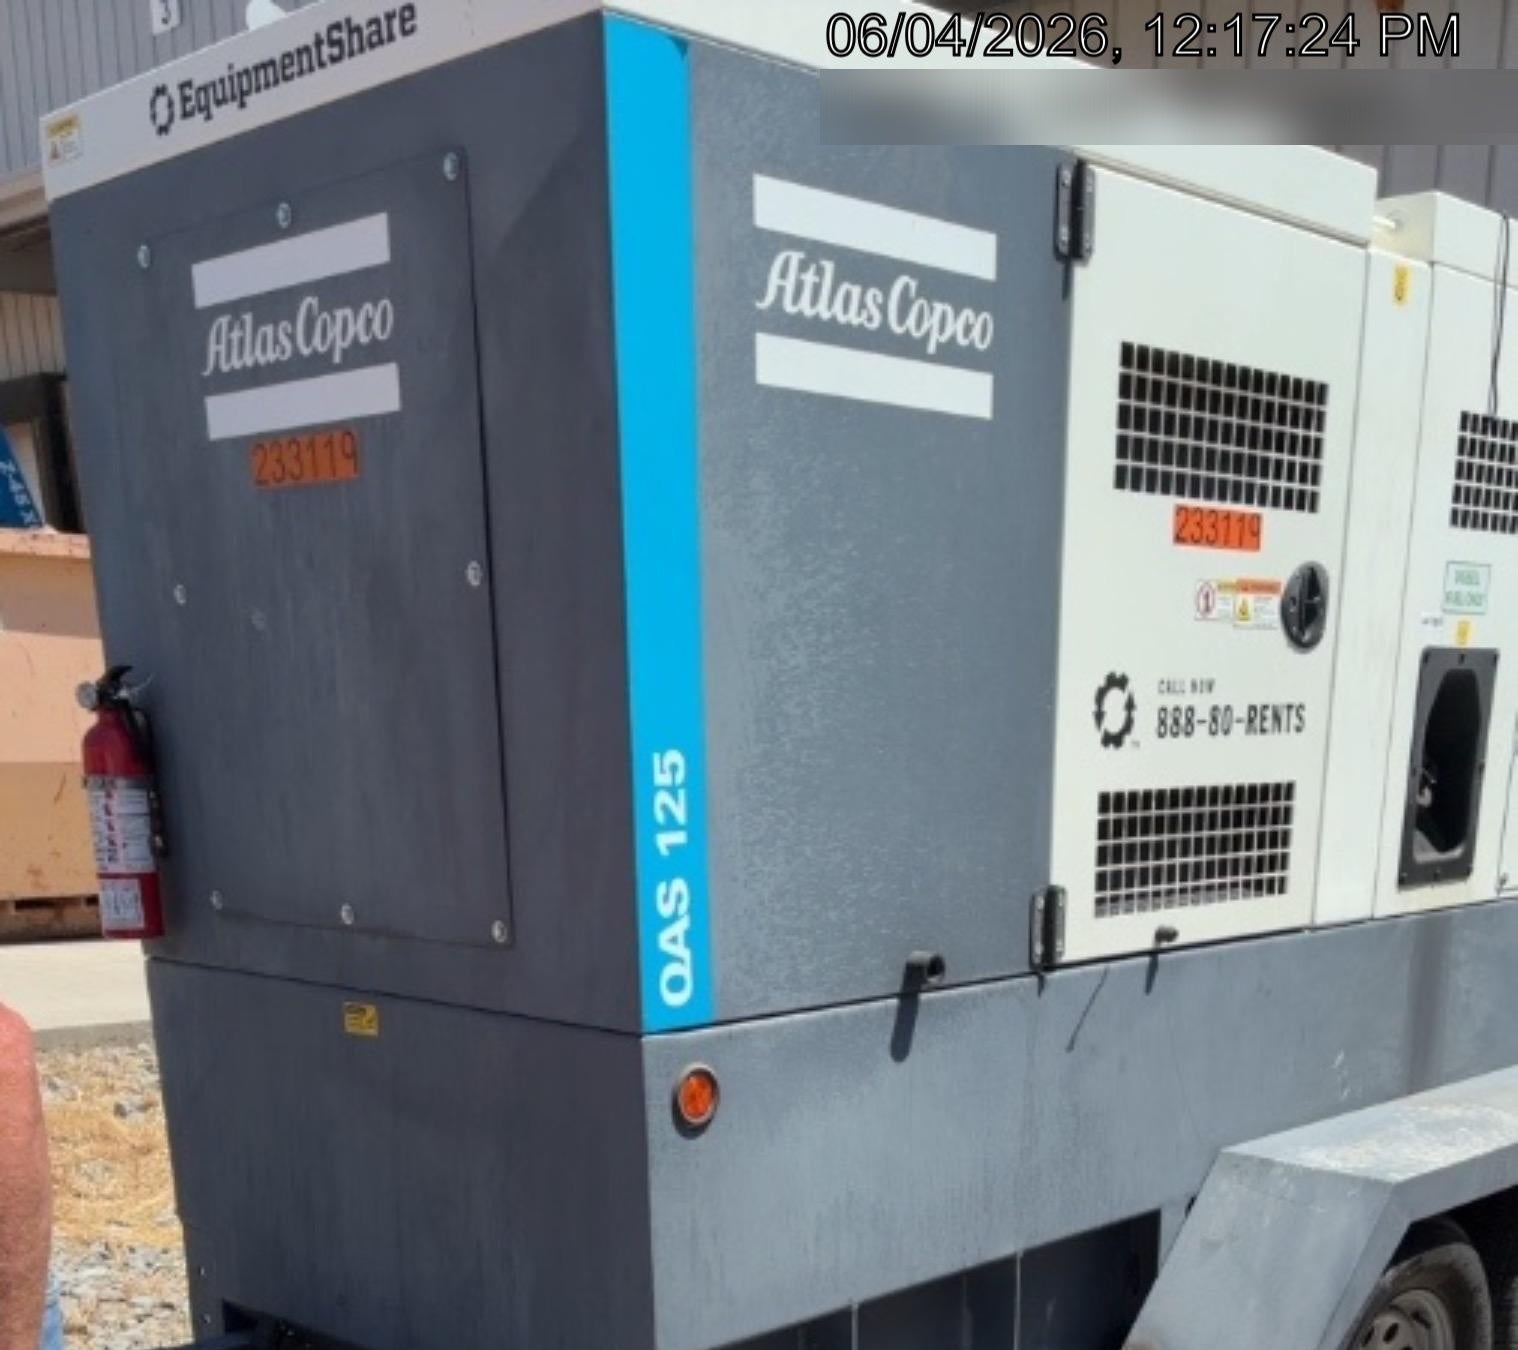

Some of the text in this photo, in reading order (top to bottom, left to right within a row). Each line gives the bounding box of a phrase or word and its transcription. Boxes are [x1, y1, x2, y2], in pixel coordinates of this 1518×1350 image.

[178, 2, 418, 121] EquipmentShare
[201, 296, 394, 378] Atlas Copco
[755, 250, 995, 355] Atlas Copco
[251, 430, 358, 485] 233119
[1157, 703, 1306, 738] 888-80-RENTS
[1158, 679, 1186, 694] CALL
[653, 749, 693, 1008] QAS 125
